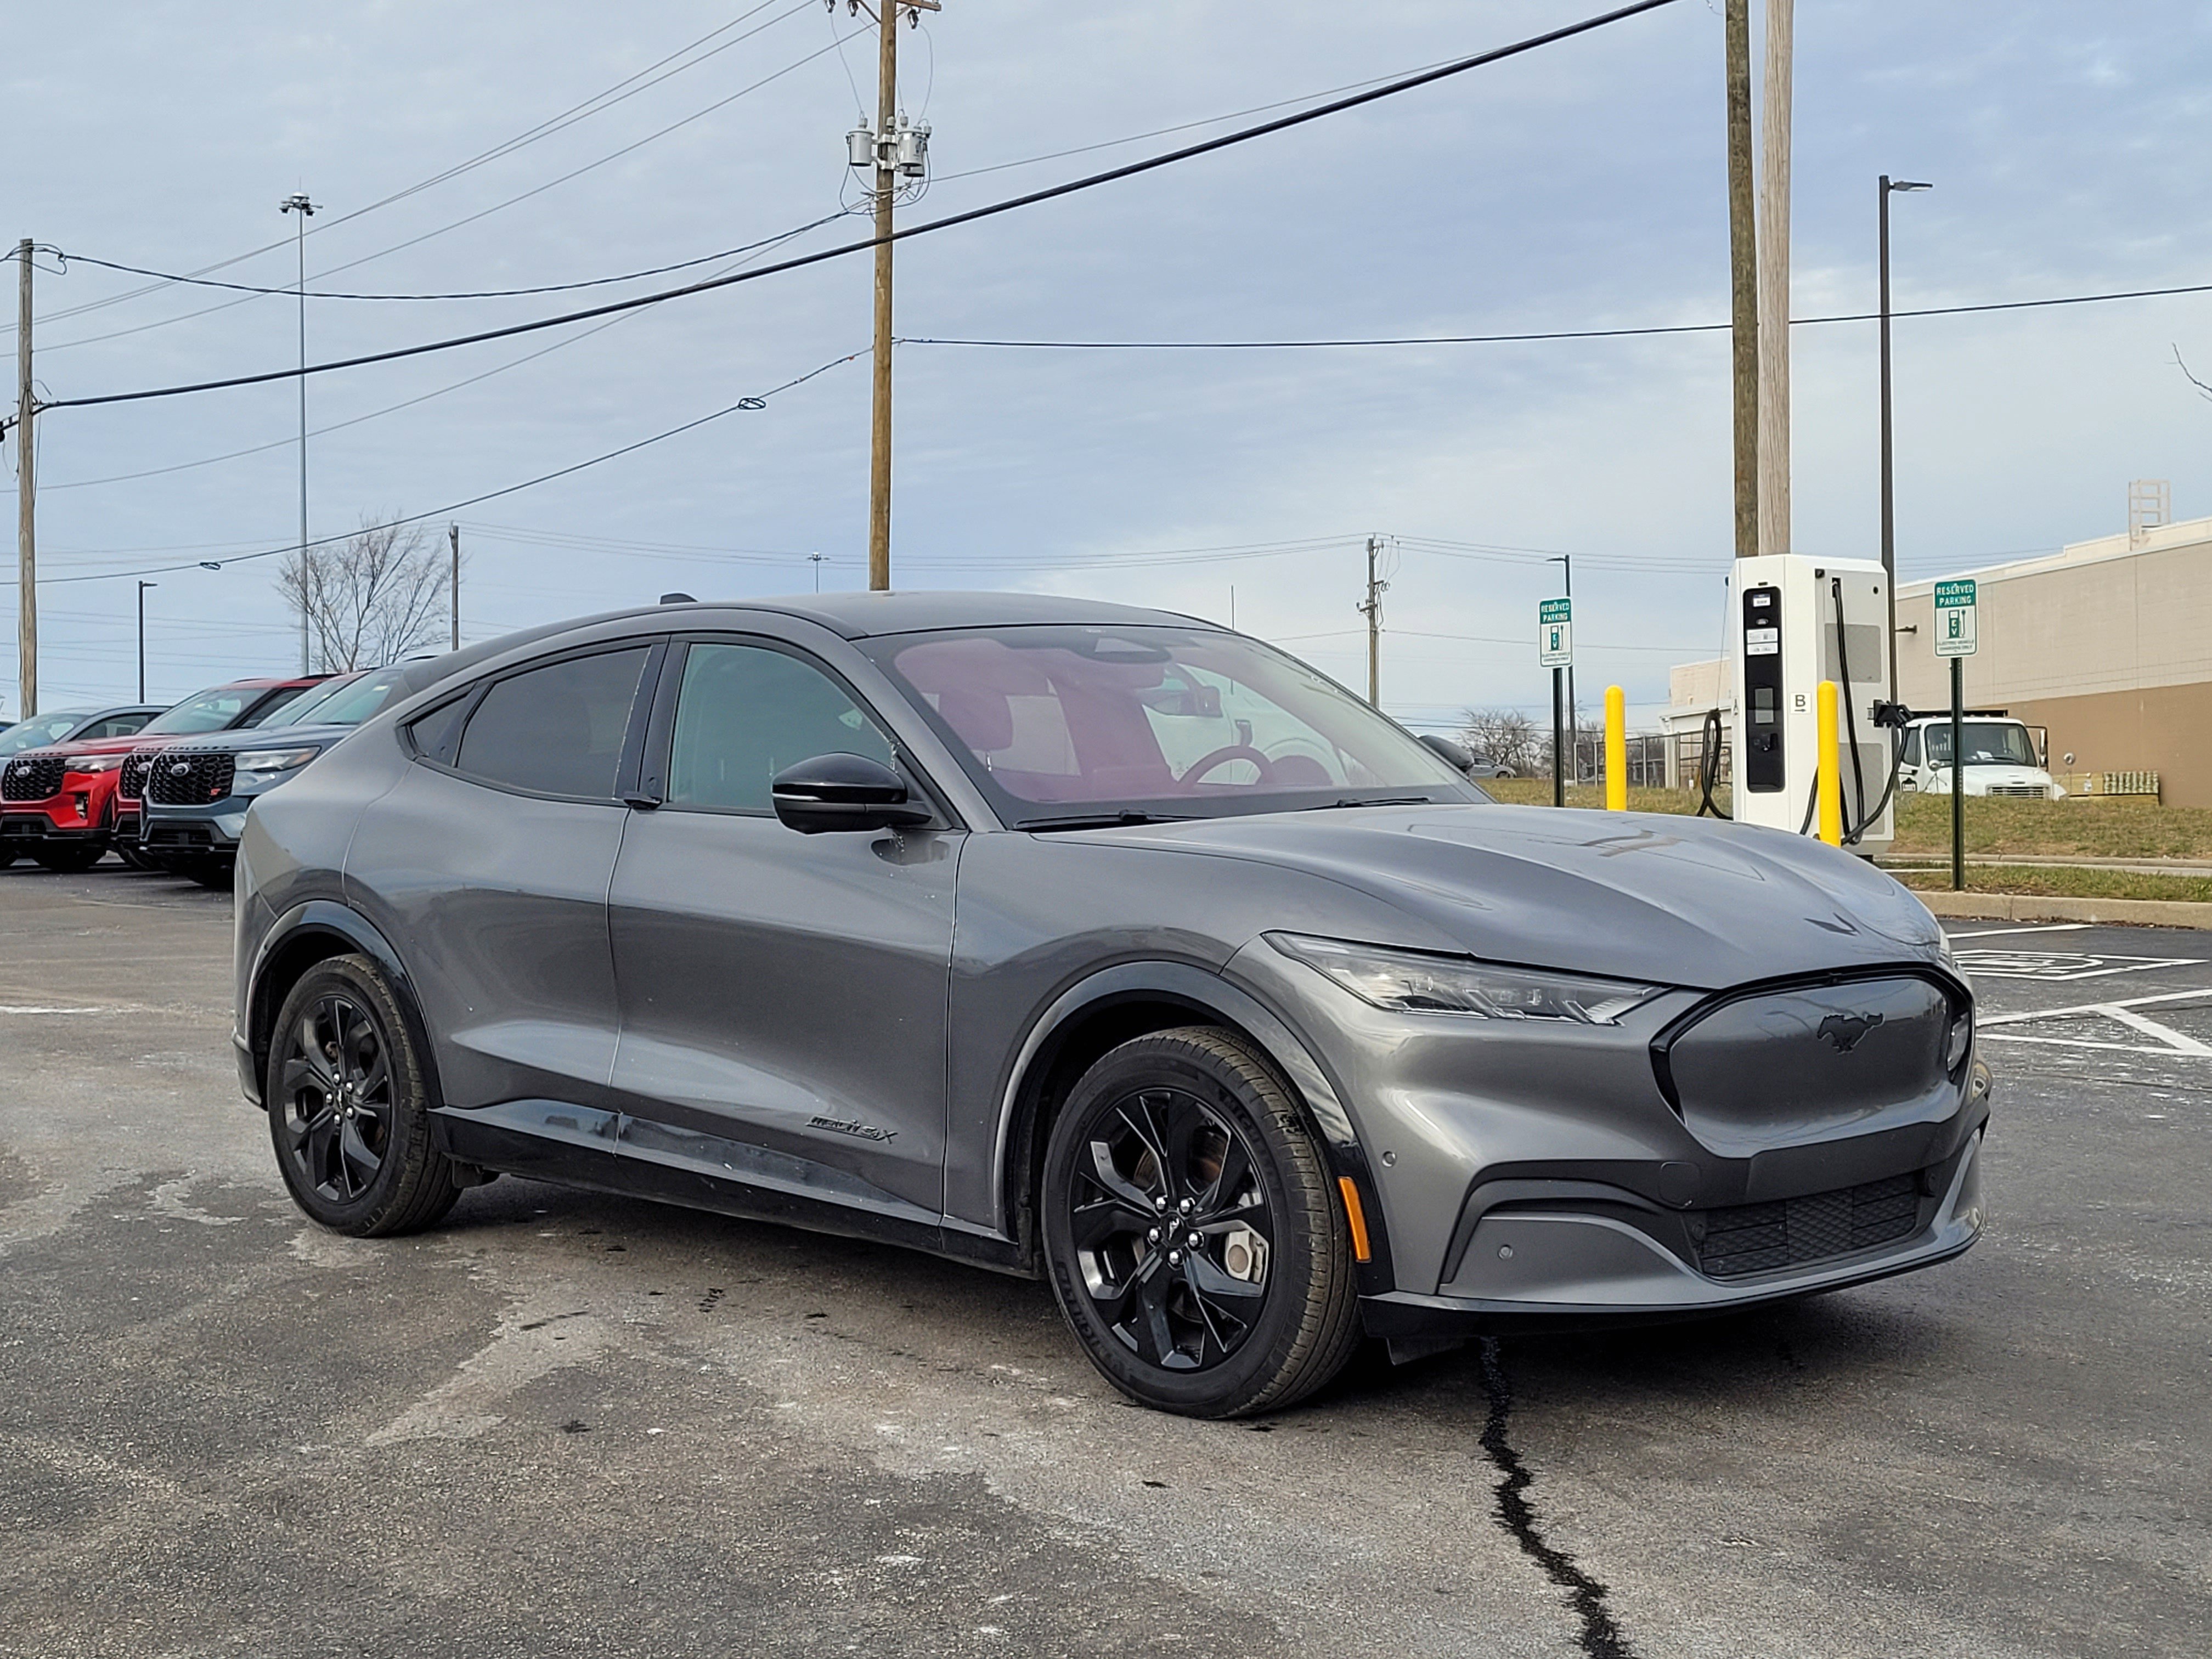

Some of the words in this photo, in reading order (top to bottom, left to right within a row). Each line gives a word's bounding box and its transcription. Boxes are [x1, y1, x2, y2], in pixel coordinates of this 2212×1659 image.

[1937, 584, 1974, 595] RESERVED
[1939, 595, 1971, 606] PARKING
[1541, 602, 1570, 612] RESERVED
[1543, 612, 1568, 623] PARKING
[1795, 695, 1805, 707] B
